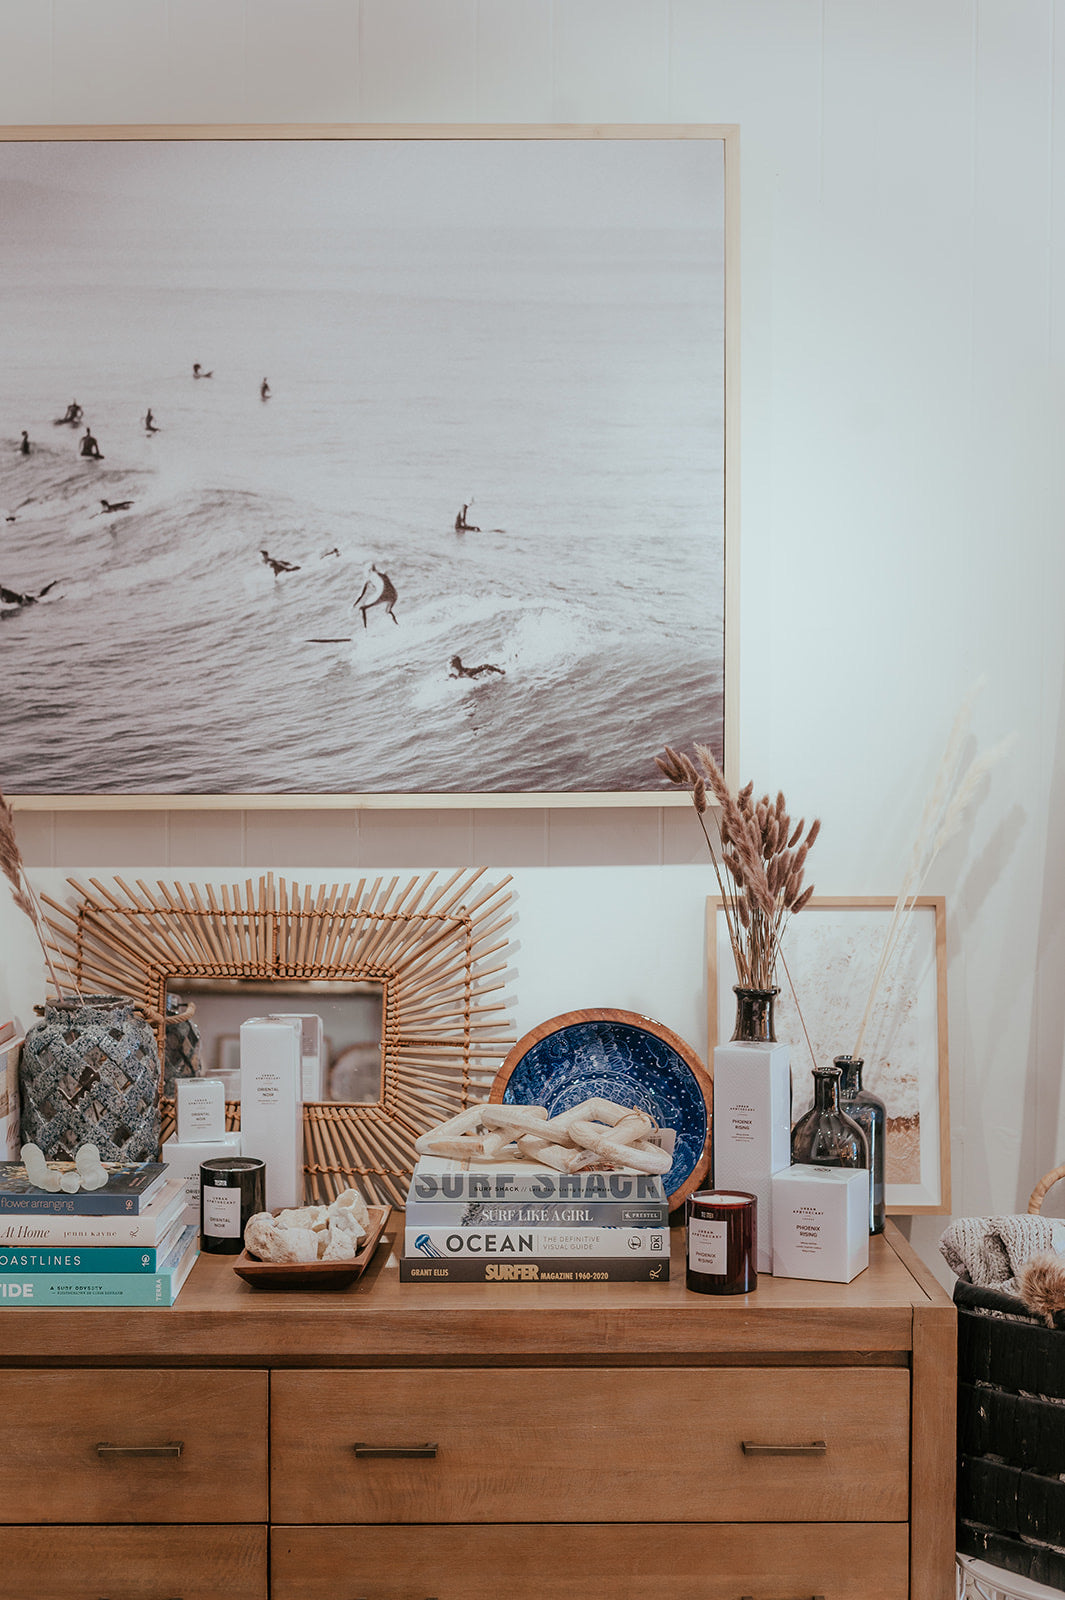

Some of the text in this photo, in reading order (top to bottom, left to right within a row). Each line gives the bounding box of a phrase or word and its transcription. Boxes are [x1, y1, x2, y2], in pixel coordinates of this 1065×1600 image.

[415, 1173, 660, 1199] SURF SHACK
[1, 1197, 75, 1212] flower arranging
[481, 1209, 594, 1221] SURF LIKE A GIRL
[1, 1225, 50, 1239] At Home
[796, 1224, 821, 1232] PHOENIX
[446, 1234, 533, 1253] OCEAN
[543, 1235, 600, 1243] THE DEFINITIVE
[0, 1255, 81, 1266] OASTLINES
[695, 1250, 717, 1258] PHOENIX
[411, 1268, 449, 1277] GRANT ELLIS
[485, 1264, 609, 1281] SURFER MAGAZINE 1960-2020
[0, 1283, 34, 1298] IDE
[155, 1278, 163, 1302] TERRA
